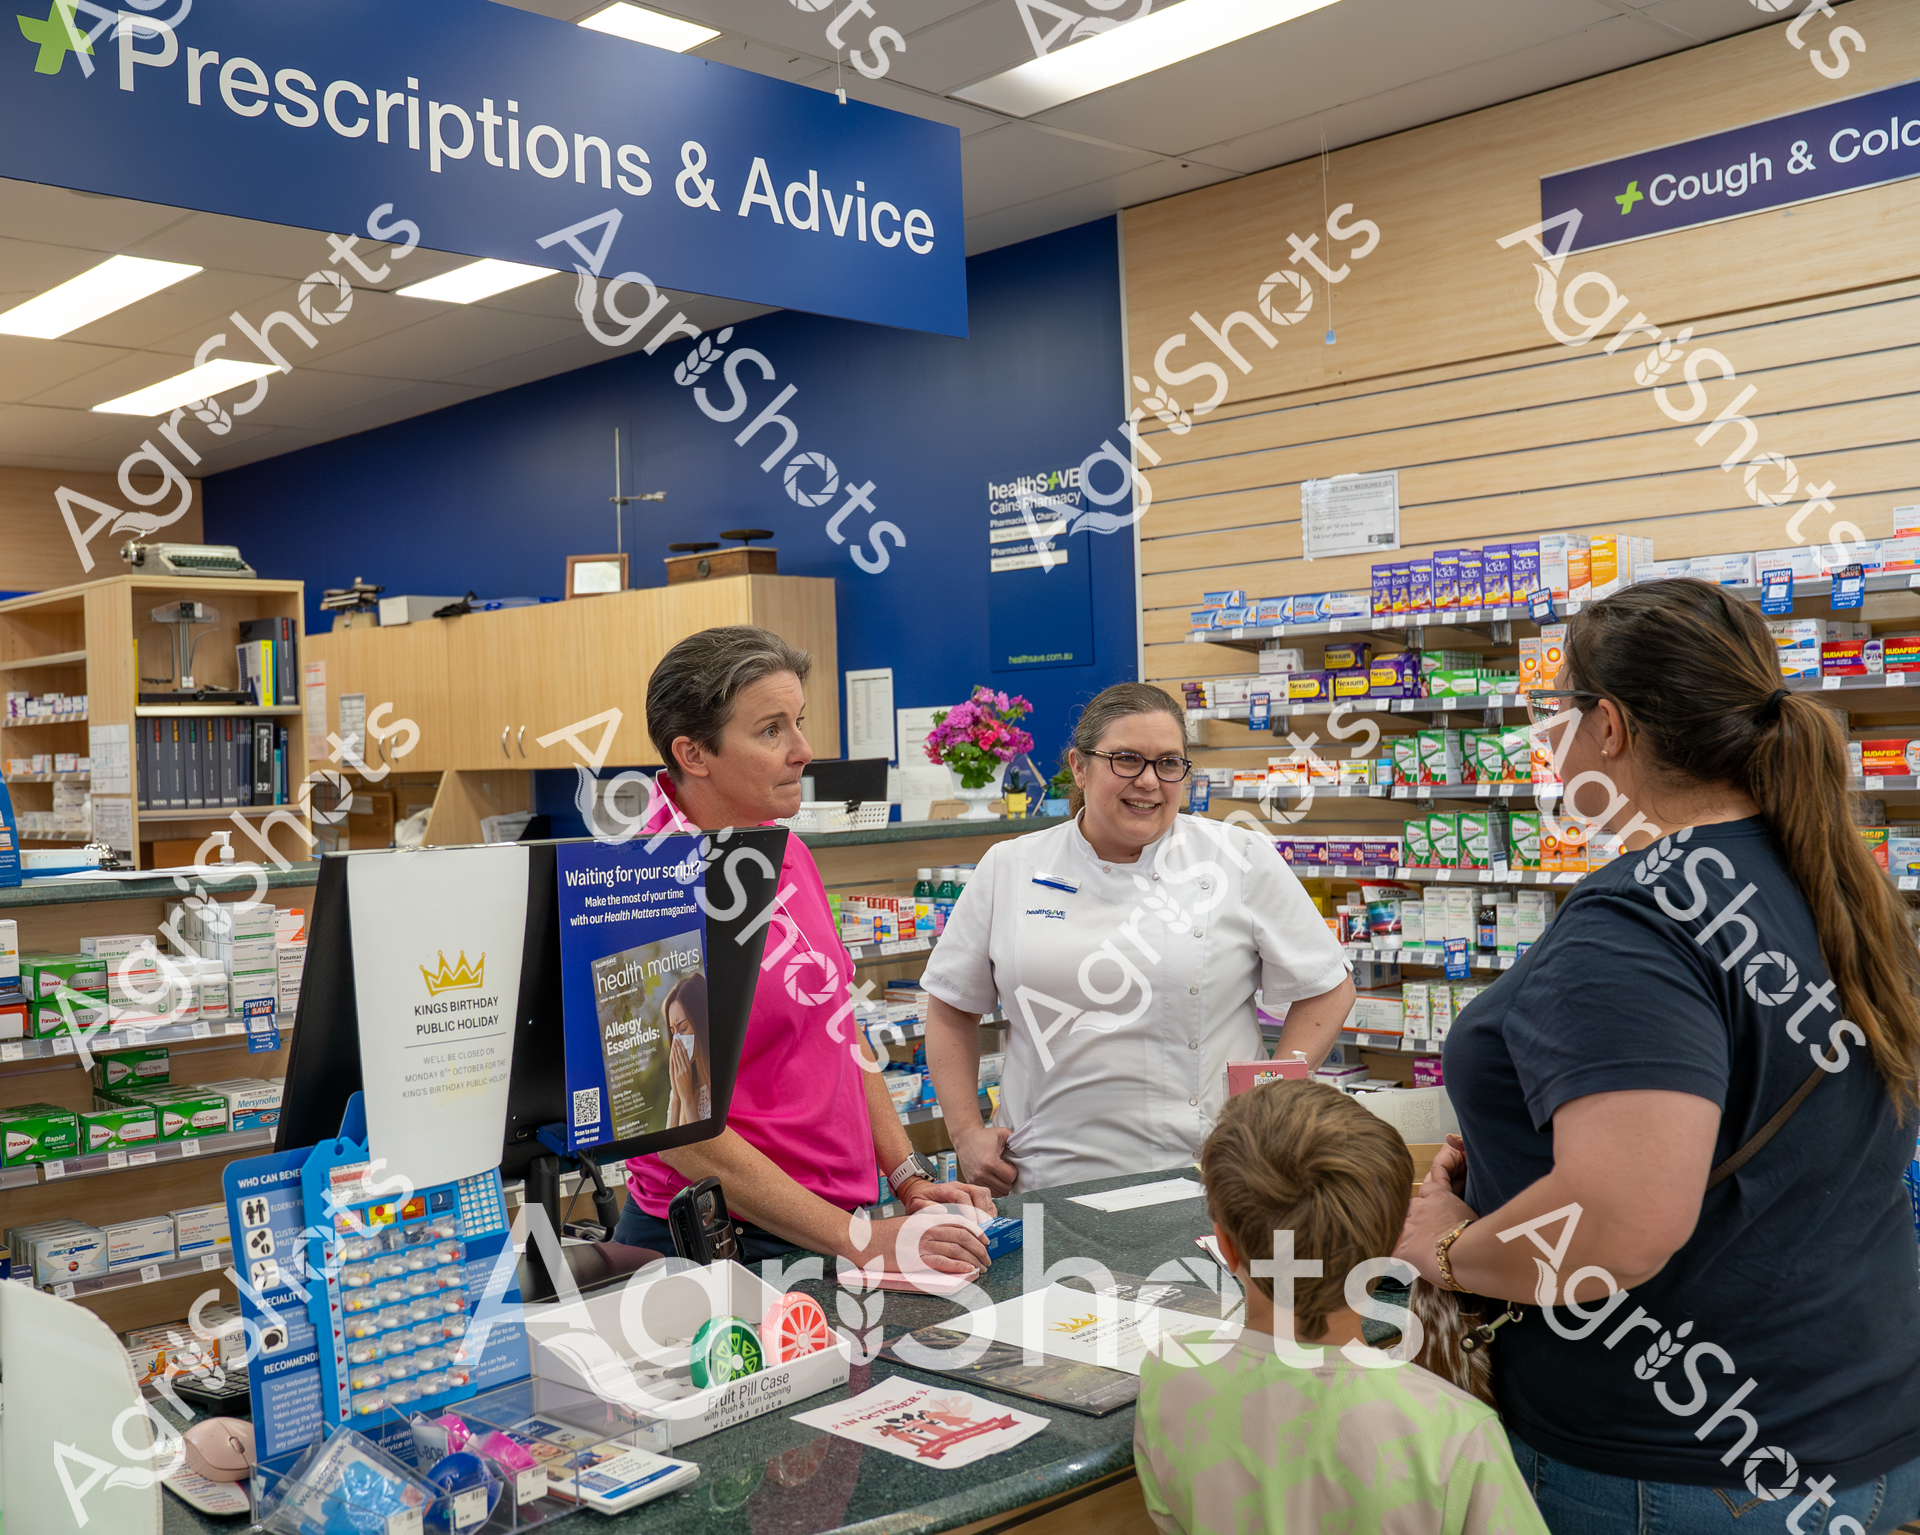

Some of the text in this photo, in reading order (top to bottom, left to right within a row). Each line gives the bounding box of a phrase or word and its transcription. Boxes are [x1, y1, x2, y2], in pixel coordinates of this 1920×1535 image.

[117, 9, 653, 196] Prescriptions
[674, 140, 721, 213] &
[738, 157, 935, 255] Advice
[1648, 152, 1774, 207] Cough
[1787, 139, 1816, 176] &
[989, 491, 1082, 516] Cains Pharmacy
[990, 545, 1028, 557] Pharmacist
[1485, 560, 1508, 574] Kids
[1513, 558, 1537, 571] Kids
[1831, 564, 1861, 574] SWITCH
[1411, 572, 1430, 584] Kids
[1435, 566, 1458, 579] Kids
[1461, 568, 1480, 580] Kids
[1763, 570, 1792, 579] SWITCH
[1840, 570, 1860, 578] SAVE
[1770, 575, 1790, 584] SAVE
[1528, 588, 1550, 601] SWITCH
[1534, 594, 1550, 604] SAVE
[1008, 652, 1073, 665] healthsave.com.au
[1325, 652, 1351, 661] Nexium
[1370, 669, 1394, 678] Nexium
[1289, 681, 1316, 690] Nexium
[1336, 680, 1365, 688] Nexium
[1294, 843, 1315, 851] Vermox
[1329, 843, 1351, 851] Vermox
[1364, 843, 1386, 851] Vermox
[565, 859, 702, 888] Waiting for your script?
[585, 888, 684, 908] Make the most of your time
[570, 902, 697, 927] with our Health Matters magazine!
[1444, 939, 1466, 948] SWITCH
[1450, 943, 1466, 951] SAVE
[279, 953, 303, 961] Panamax
[597, 960, 644, 994] health
[647, 948, 700, 977] matters
[244, 999, 274, 1010] SWITCH
[251, 1006, 271, 1015] SAVE
[414, 996, 499, 1016] KINGS BIRTHDAY
[41, 1016, 61, 1024] Panadol
[416, 1014, 499, 1035] PUBLIC HOLIDAY
[605, 1017, 642, 1040] Allergy
[606, 1026, 661, 1056] Essentials:
[423, 1047, 495, 1065] WE'LL BE CLOSED ON
[109, 1067, 127, 1075] Panadol
[405, 1071, 439, 1083] MONDAY
[452, 1063, 485, 1076] OCTOBER
[485, 1061, 497, 1070] FOR
[402, 1088, 428, 1099] KING'S
[429, 1082, 465, 1095] BIRTHDAY
[466, 1077, 488, 1089] PUBLIC
[237, 1095, 281, 1109] Mersynofen
[165, 1118, 184, 1126] Panadol
[205, 1114, 219, 1122] Caps
[91, 1131, 110, 1139] Panadol
[122, 1127, 142, 1135] Tablets
[8, 1139, 31, 1148] Panadol
[45, 1133, 66, 1143] Rapid
[237, 1177, 259, 1189] WHO
[260, 1172, 278, 1185] CAN
[270, 1201, 297, 1213] ELDERLY
[180, 1226, 200, 1234] Ibuprofen
[109, 1242, 131, 1250] Ibuprofen
[119, 1243, 145, 1253] Paracetamol
[256, 1290, 303, 1310] SPECIALITY
[272, 1390, 298, 1402] everyone
[707, 1372, 790, 1412] Fruit Pill Case
[704, 1384, 792, 1422] with Push & Turn Opening
[713, 1399, 782, 1430] wicked sista
[842, 1418, 859, 1428] IN
[859, 1395, 922, 1422] OCTOBER
[285, 1416, 302, 1428] using
[301, 1414, 311, 1423] the
[275, 1428, 298, 1440] manage
